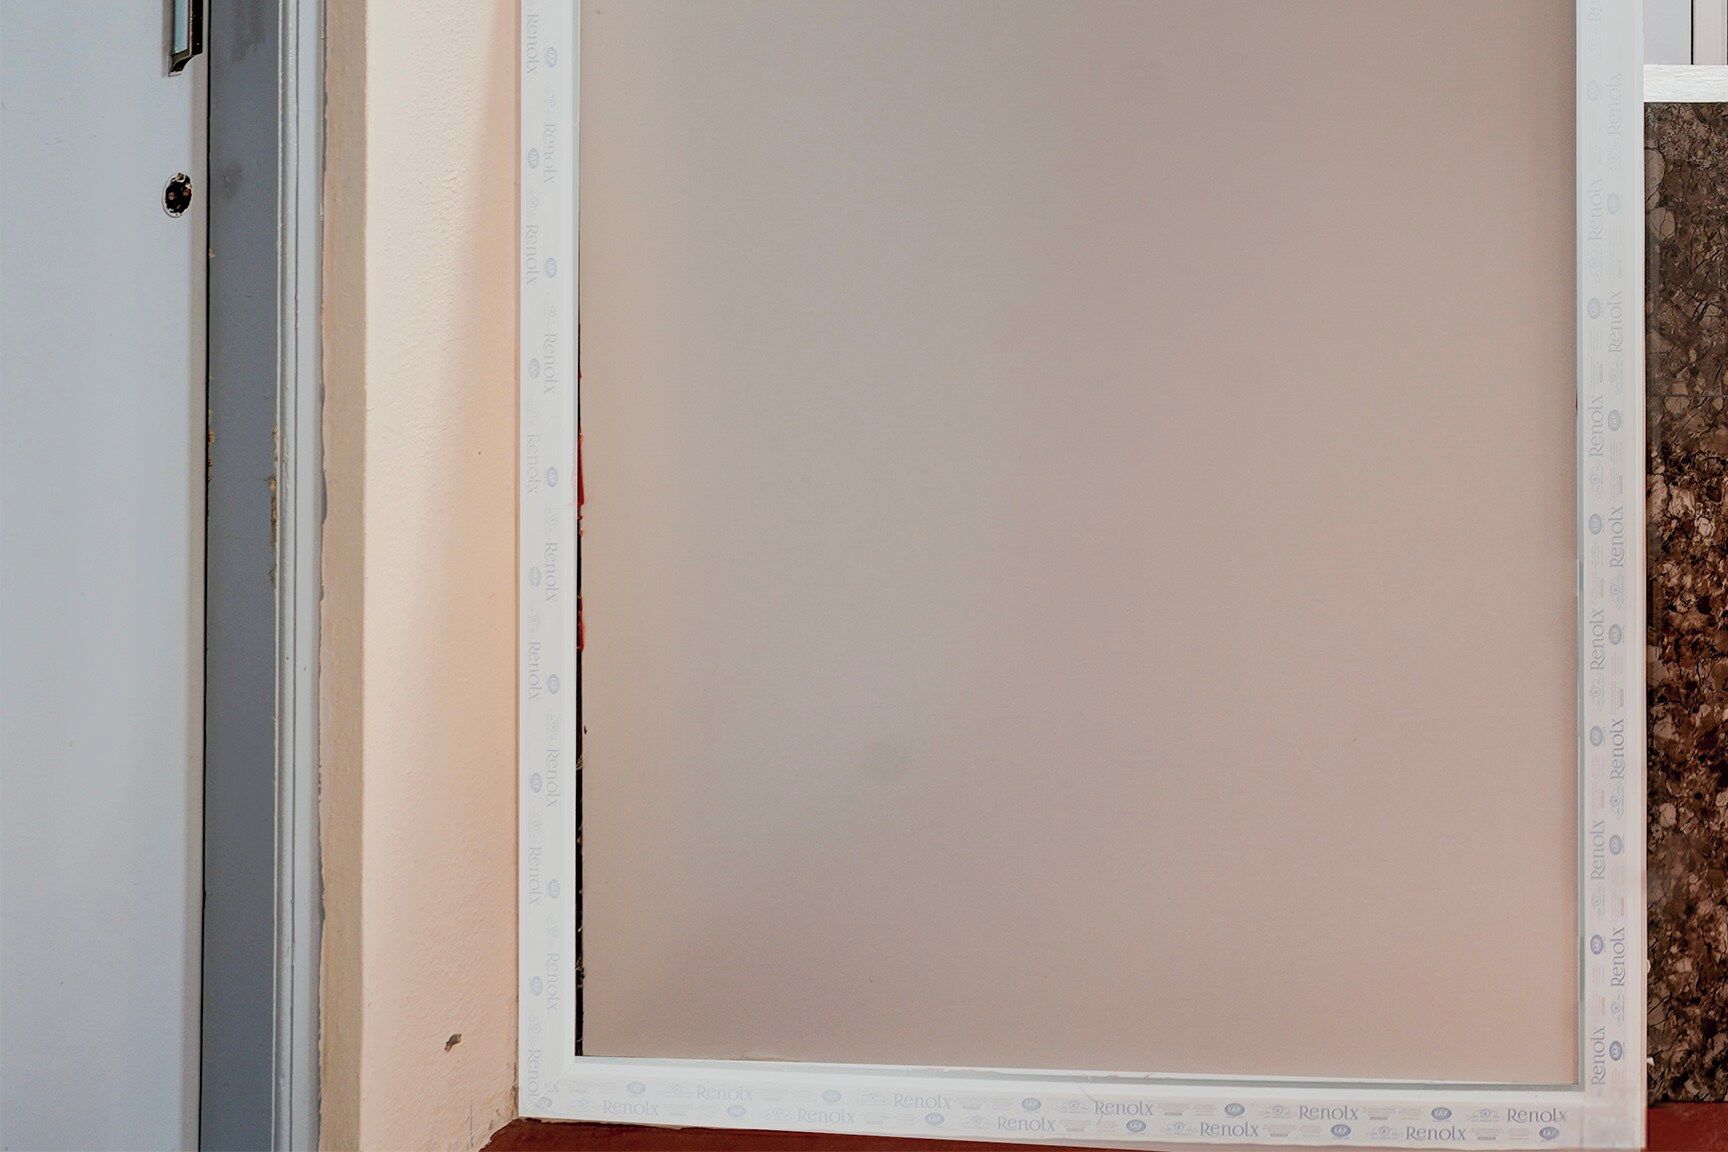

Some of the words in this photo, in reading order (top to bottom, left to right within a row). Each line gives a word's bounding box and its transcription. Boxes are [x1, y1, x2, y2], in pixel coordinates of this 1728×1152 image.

[525, 13, 542, 75] Renolx
[1605, 71, 1623, 137] Renolx
[542, 122, 559, 184] Renolx
[524, 223, 541, 285] Renolx
[1607, 290, 1625, 354] Renolx
[542, 332, 559, 394] Renolx
[1587, 394, 1605, 458] Renolx
[525, 433, 542, 495] Renolx
[1608, 505, 1626, 569] Renolx
[543, 541, 560, 603] Renolx
[526, 640, 543, 702] Renolx
[1589, 609, 1606, 671] Renolx
[545, 748, 561, 808] Renolx
[1609, 718, 1626, 780] Renolx
[527, 846, 543, 906] Renolx
[1589, 819, 1606, 881] Renolx
[1609, 926, 1626, 988] Renolx
[1590, 1026, 1606, 1086] Renolx
[797, 1108, 855, 1124] Renolx
[893, 1093, 951, 1109] Renolx
[996, 1115, 1056, 1131] Renolx
[1094, 1100, 1154, 1116] Renolx
[1199, 1121, 1259, 1137] Renolx
[1298, 1104, 1360, 1121] Renolx
[1506, 1107, 1568, 1124] Renolx
[1405, 1125, 1467, 1142] Renolx
